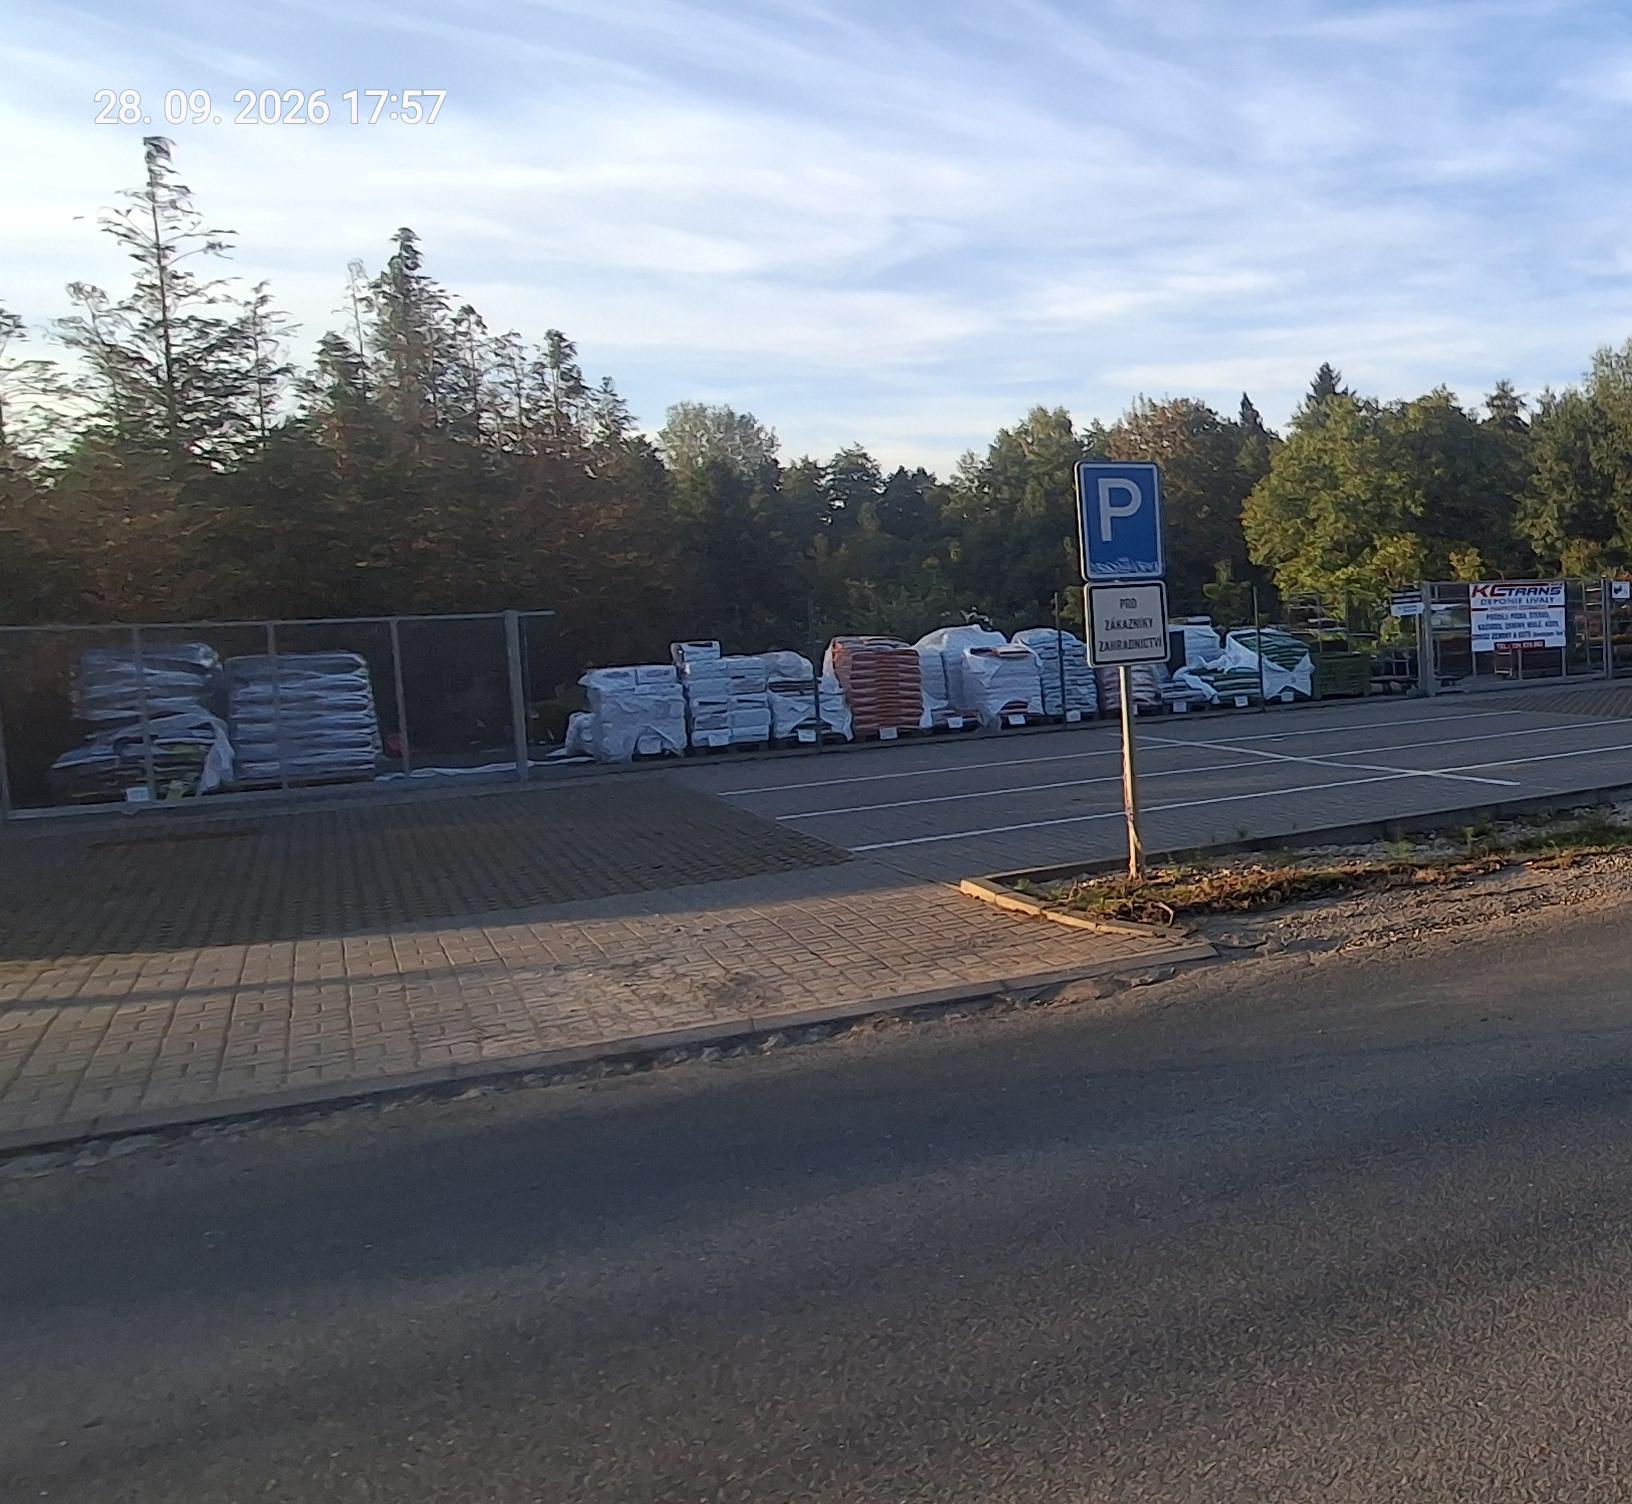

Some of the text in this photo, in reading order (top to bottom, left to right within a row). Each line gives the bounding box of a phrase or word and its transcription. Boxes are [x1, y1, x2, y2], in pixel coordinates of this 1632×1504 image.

[1098, 478, 1142, 541] P
[1119, 598, 1137, 609] PRO
[1104, 616, 1153, 631] ZÁKAZNÍKY
